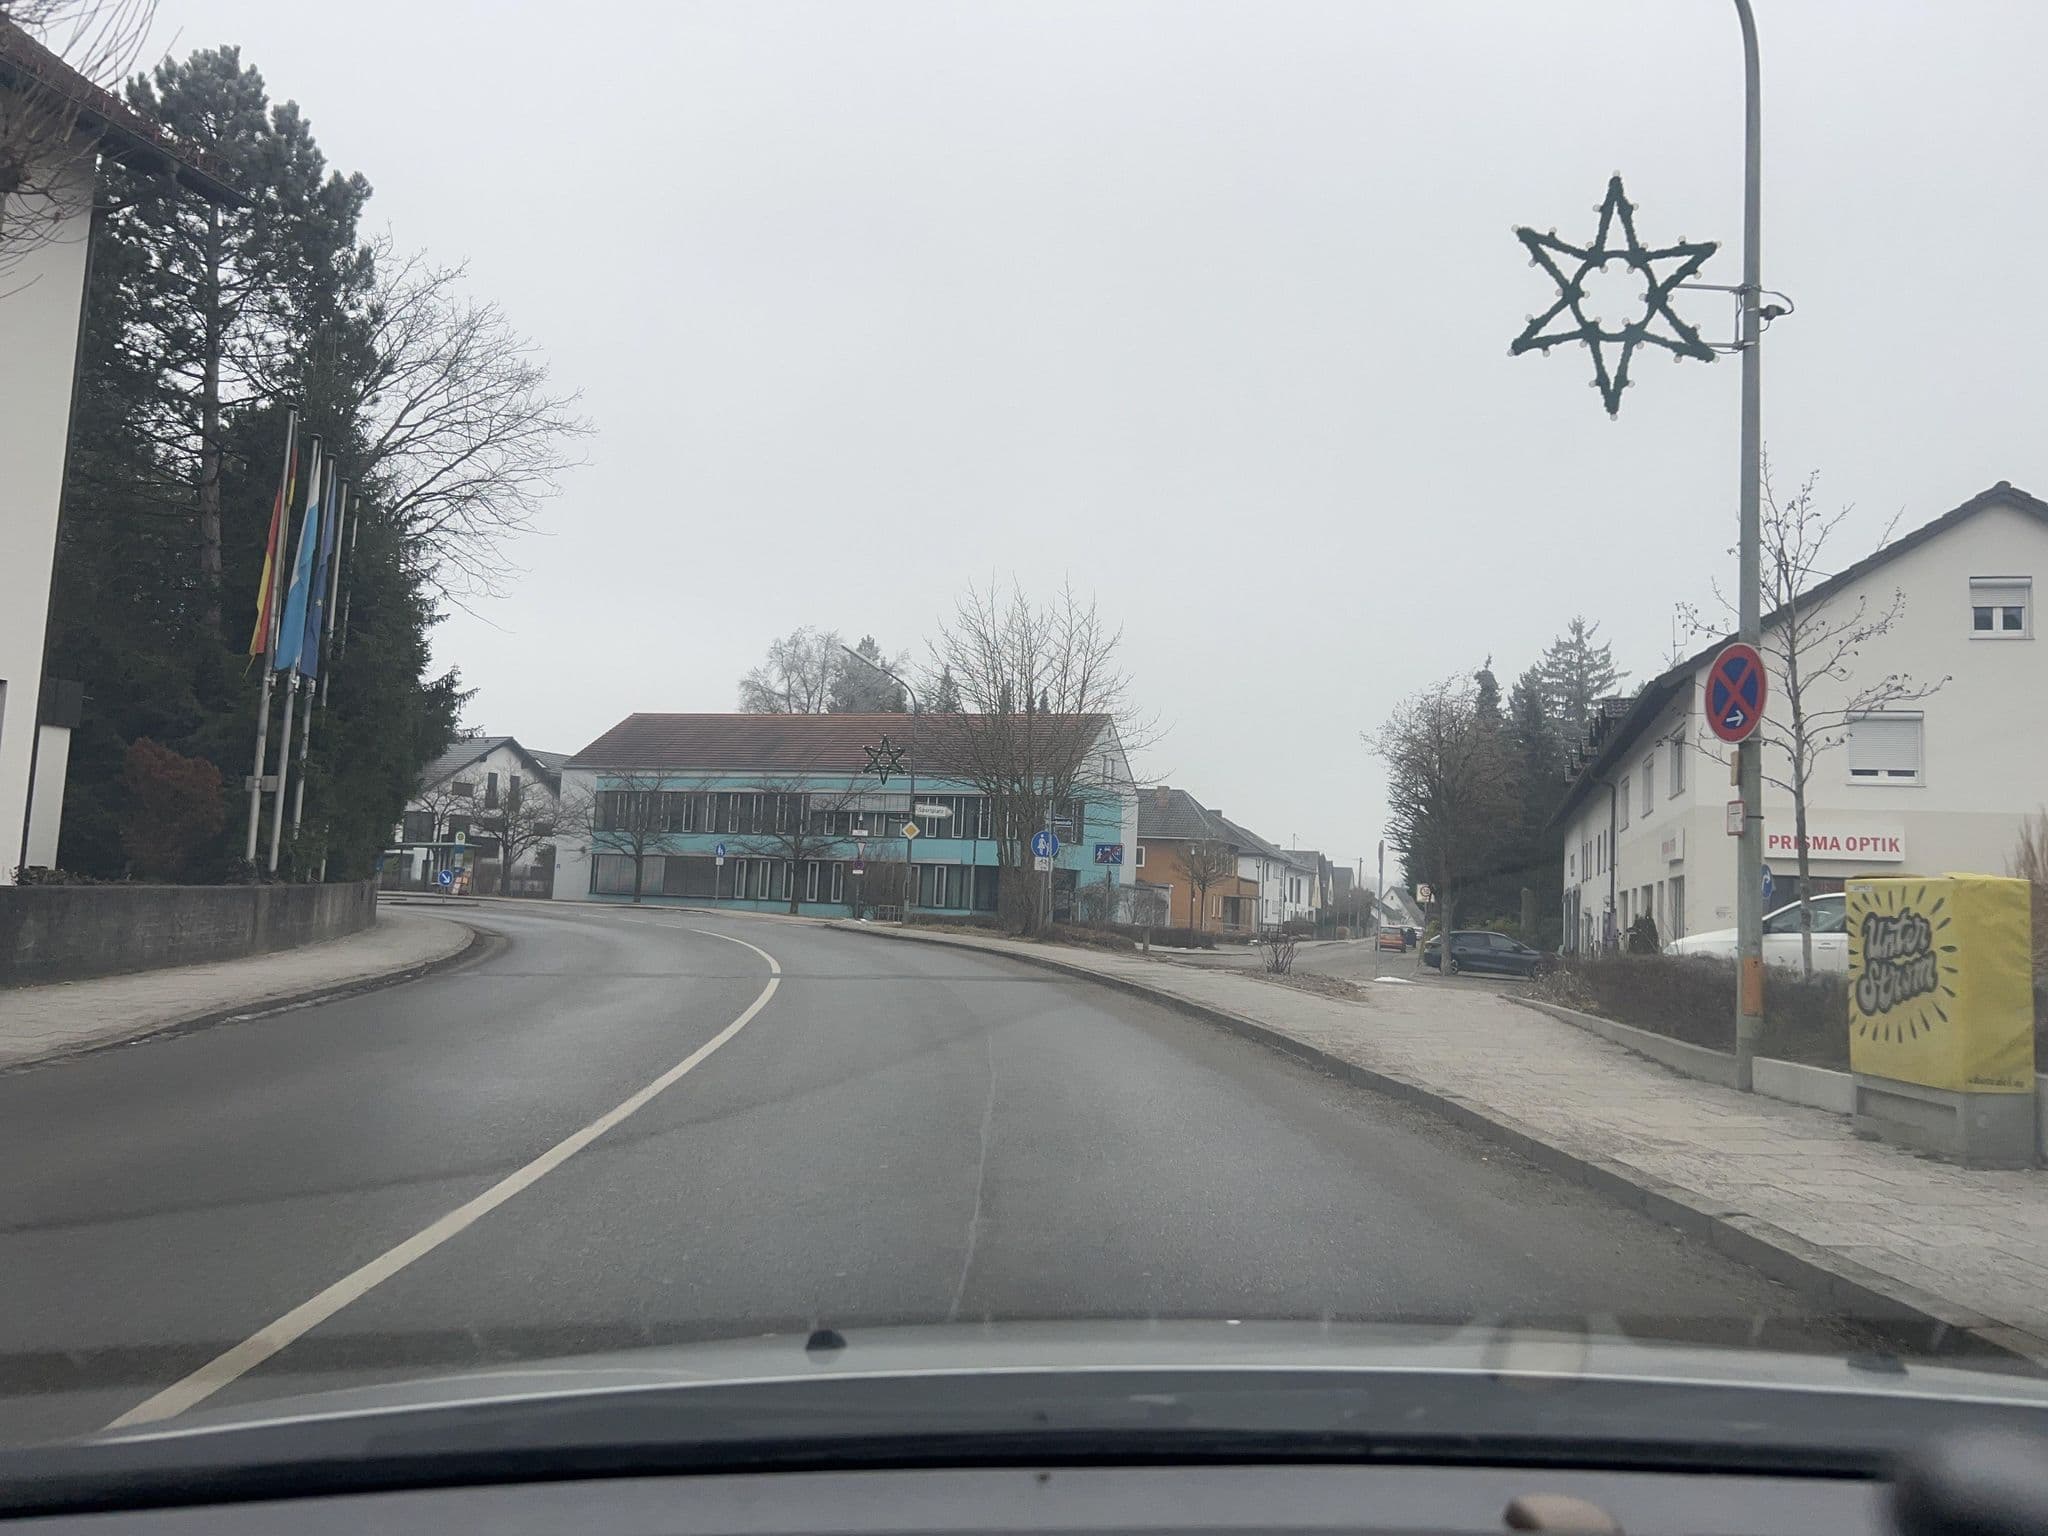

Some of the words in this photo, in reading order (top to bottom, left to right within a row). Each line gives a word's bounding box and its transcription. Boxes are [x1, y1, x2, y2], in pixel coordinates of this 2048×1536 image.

[1768, 835, 1841, 851] PRISMA
[1845, 836, 1900, 853] OPTIK
[1862, 907, 1931, 957] Unter
[1857, 948, 1938, 1016] Strom
